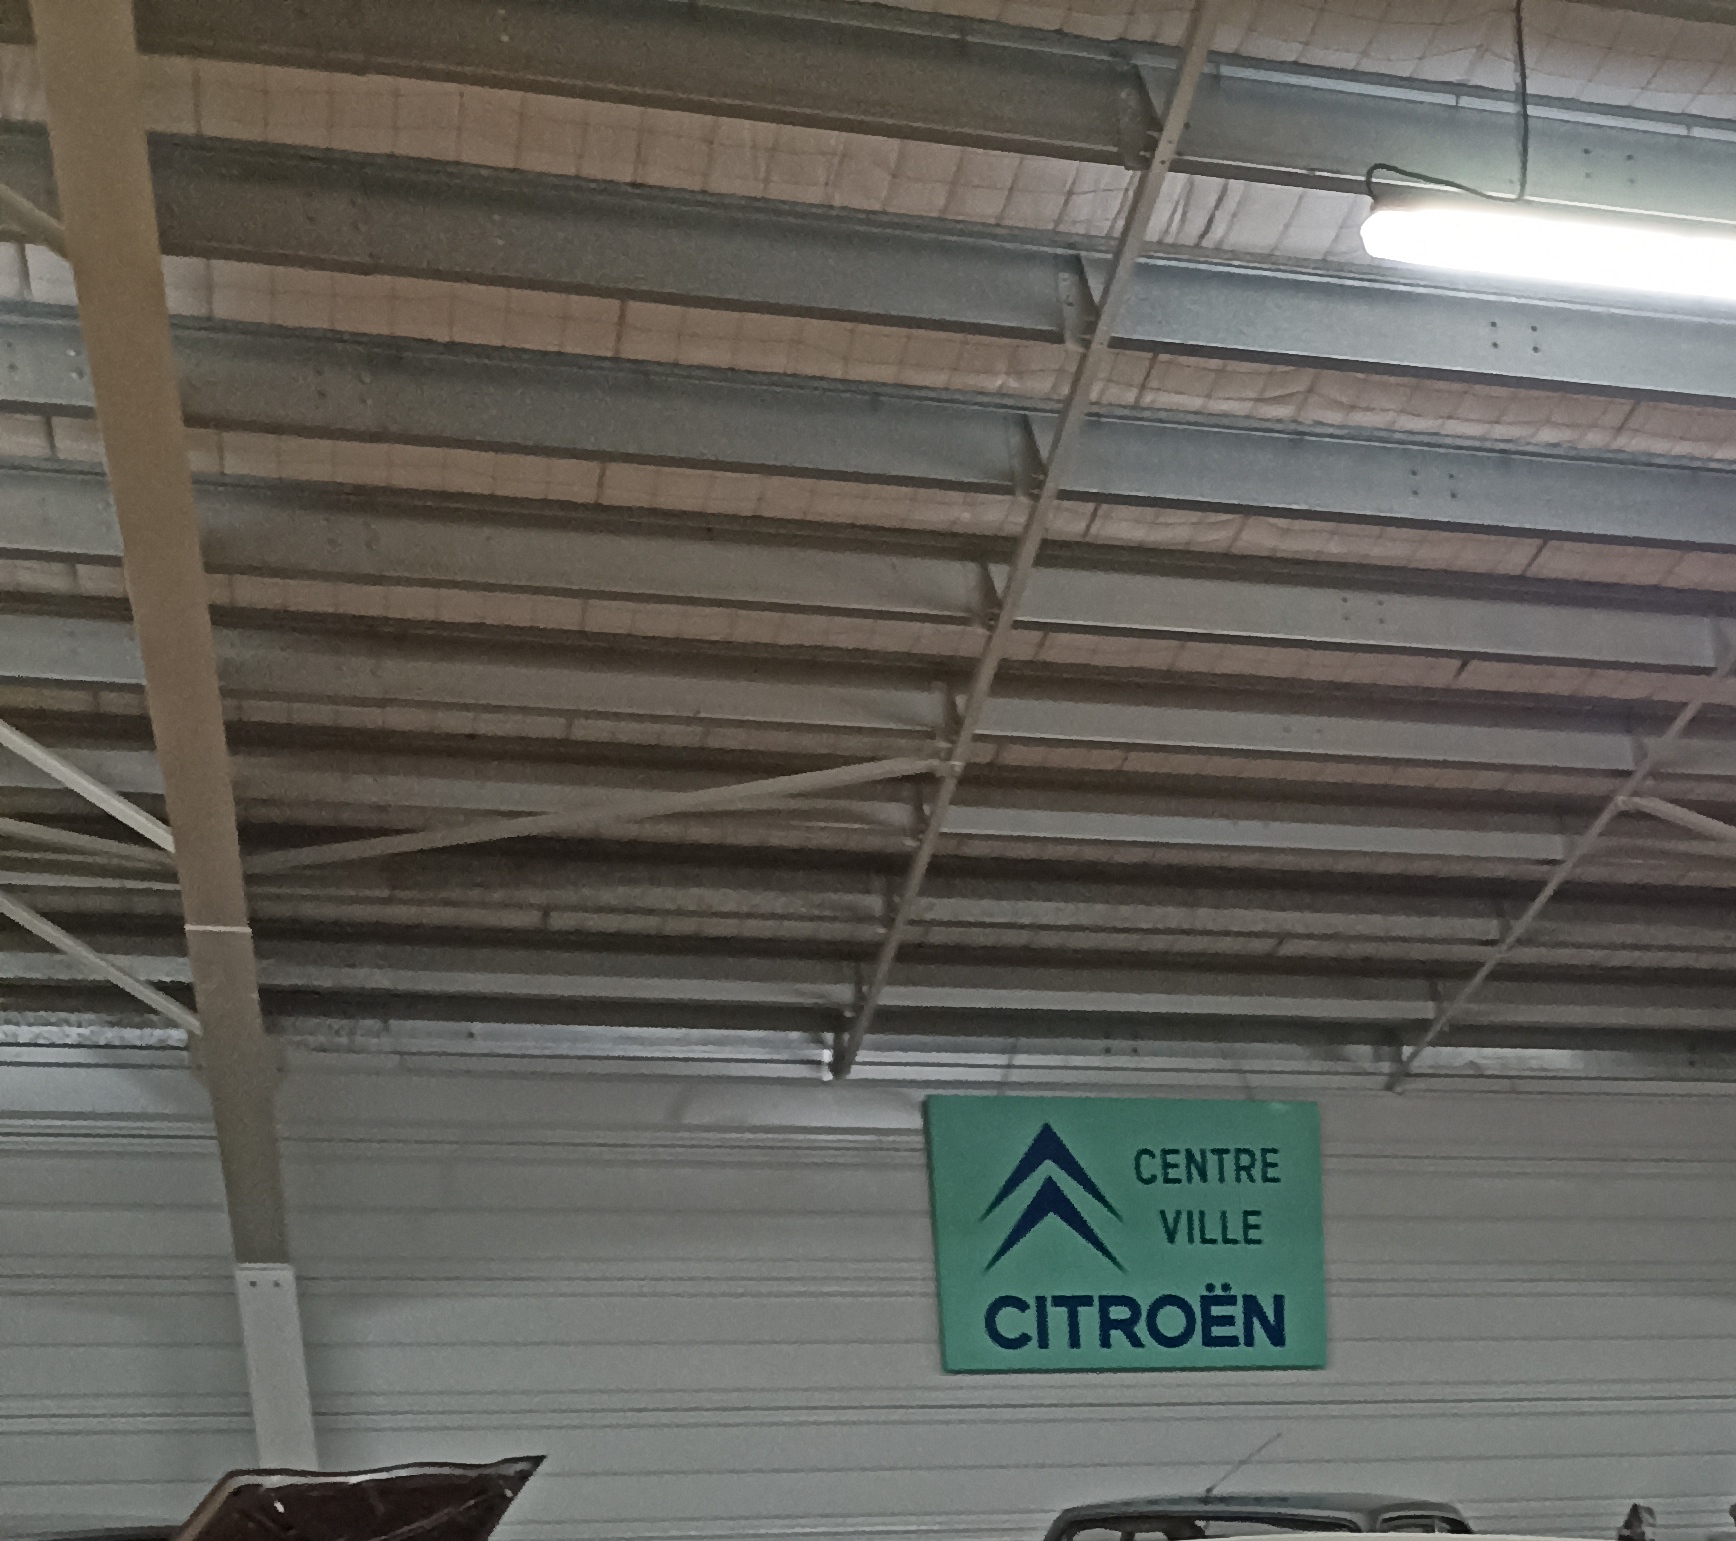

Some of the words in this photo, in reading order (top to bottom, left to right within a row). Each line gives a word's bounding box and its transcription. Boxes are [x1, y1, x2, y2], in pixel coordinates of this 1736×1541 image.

[1134, 1148, 1281, 1184] CENTRE
[1160, 1210, 1262, 1245] VILLE
[984, 1282, 1286, 1350] CITROËN
